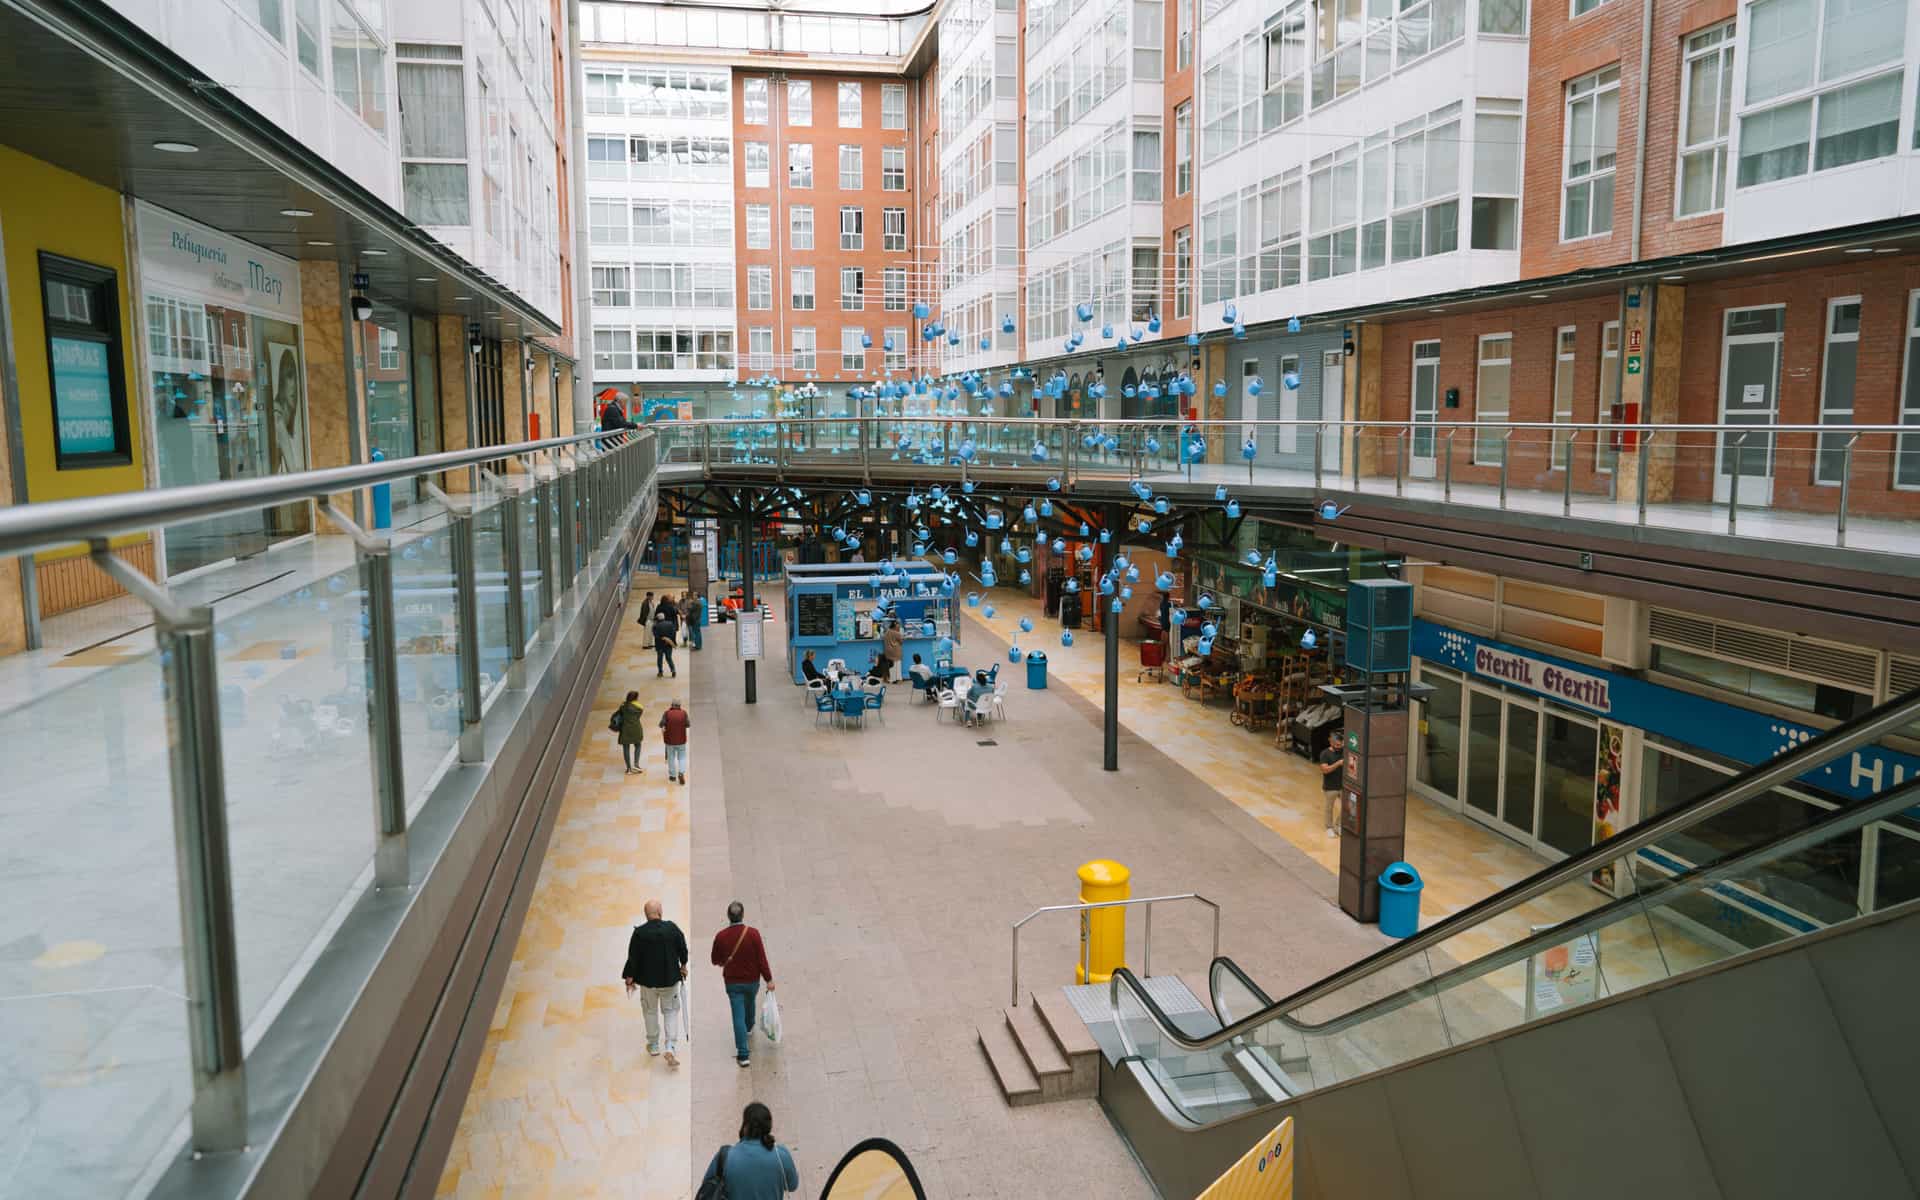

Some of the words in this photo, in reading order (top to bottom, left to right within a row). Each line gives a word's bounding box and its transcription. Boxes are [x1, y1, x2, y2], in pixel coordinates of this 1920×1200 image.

[248, 260, 282, 304] Mary
[848, 589, 863, 600] EL
[880, 588, 907, 598] FARO
